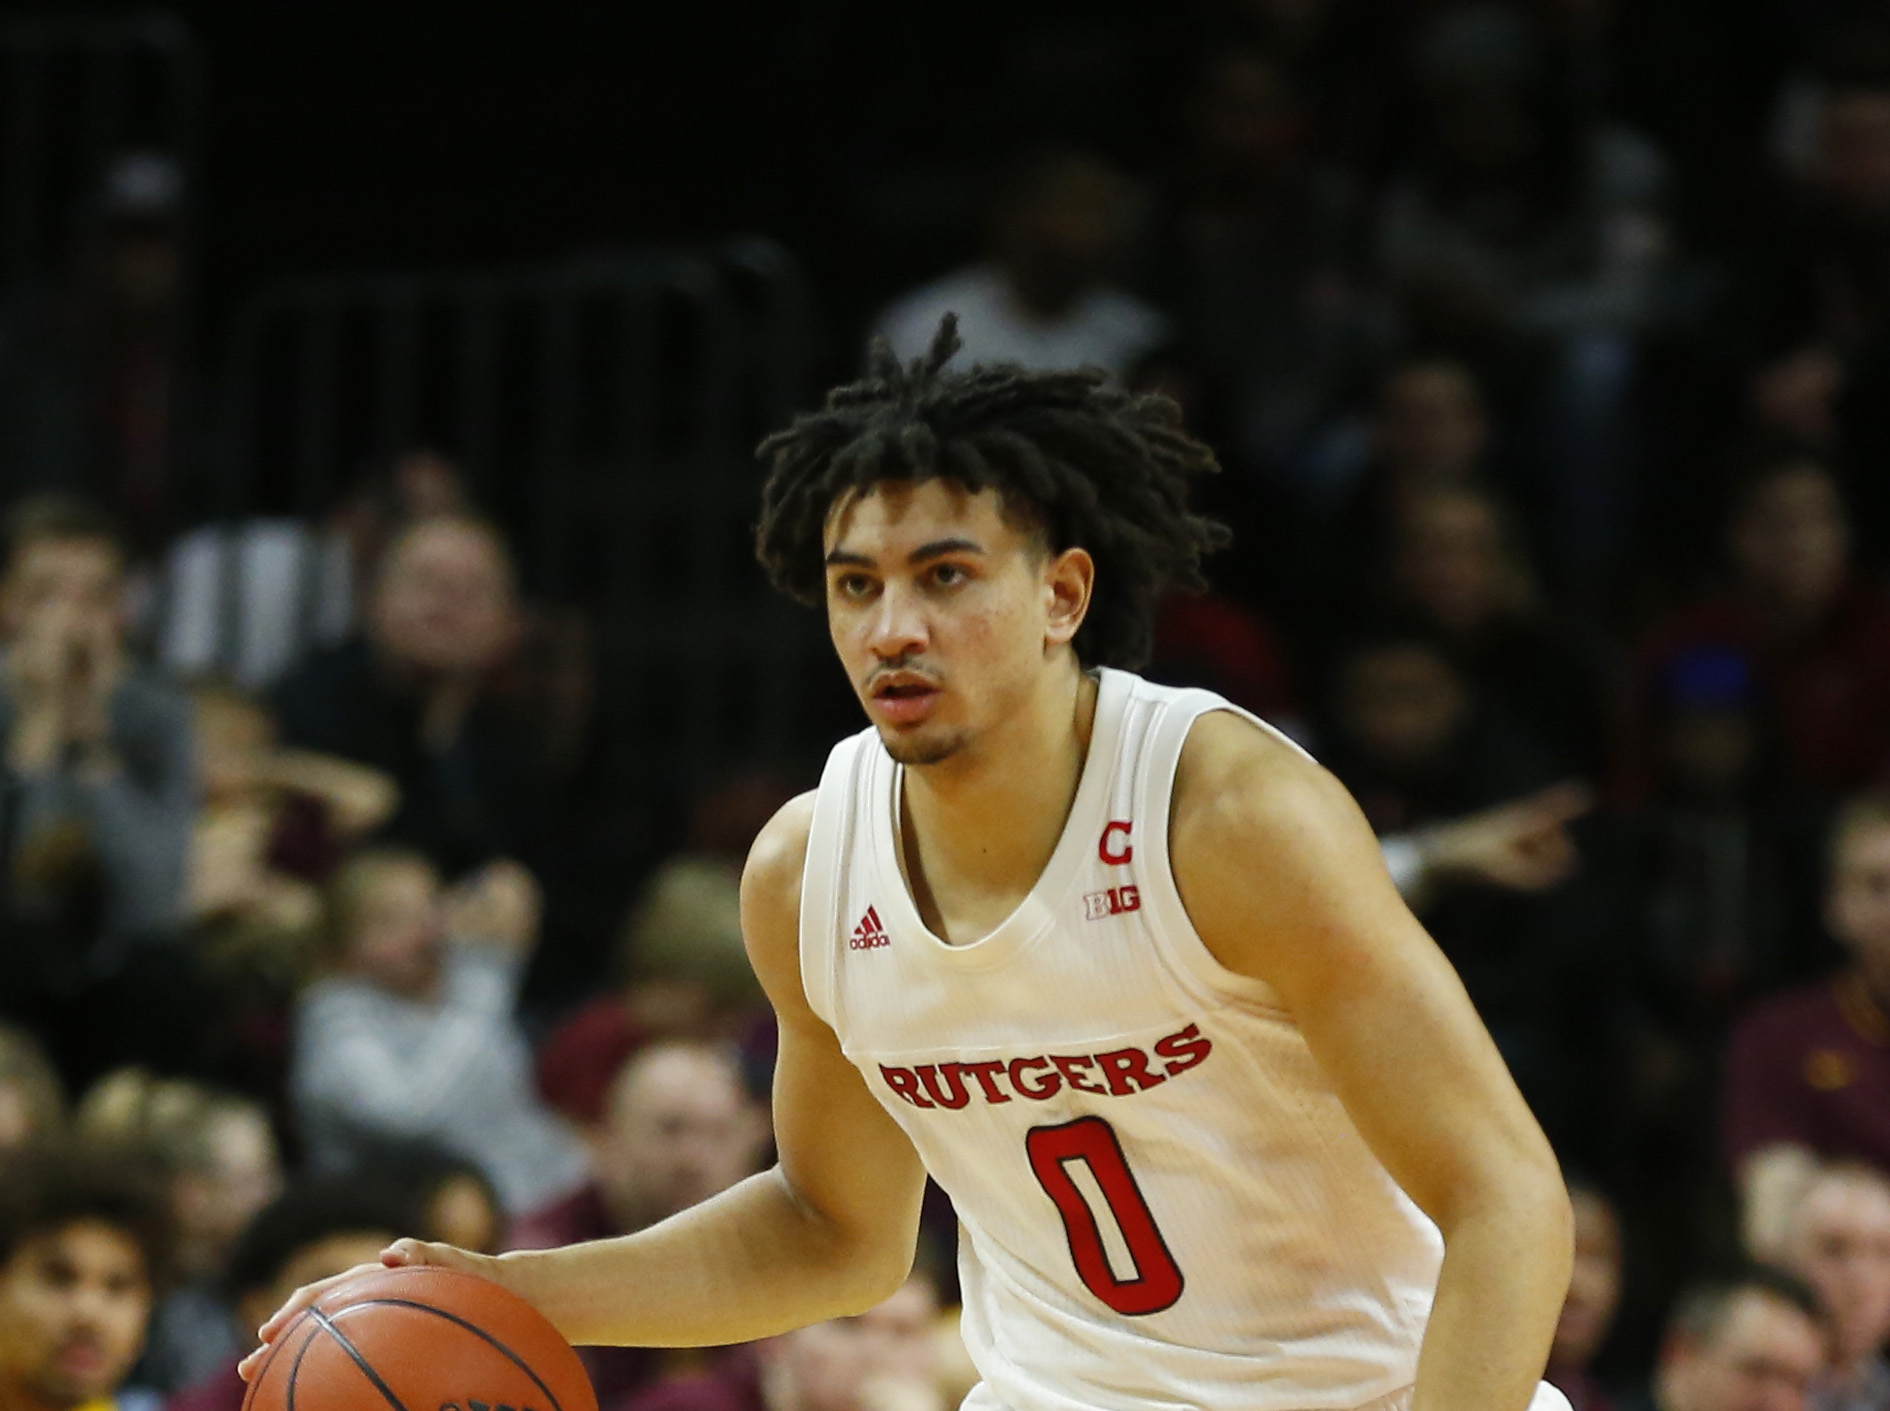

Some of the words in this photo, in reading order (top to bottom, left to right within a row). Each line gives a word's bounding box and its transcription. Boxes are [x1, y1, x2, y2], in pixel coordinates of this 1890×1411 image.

[1099, 821, 1133, 866] C
[879, 1022, 1213, 1110] RUTGERS
[1025, 1114, 1185, 1317] 0
